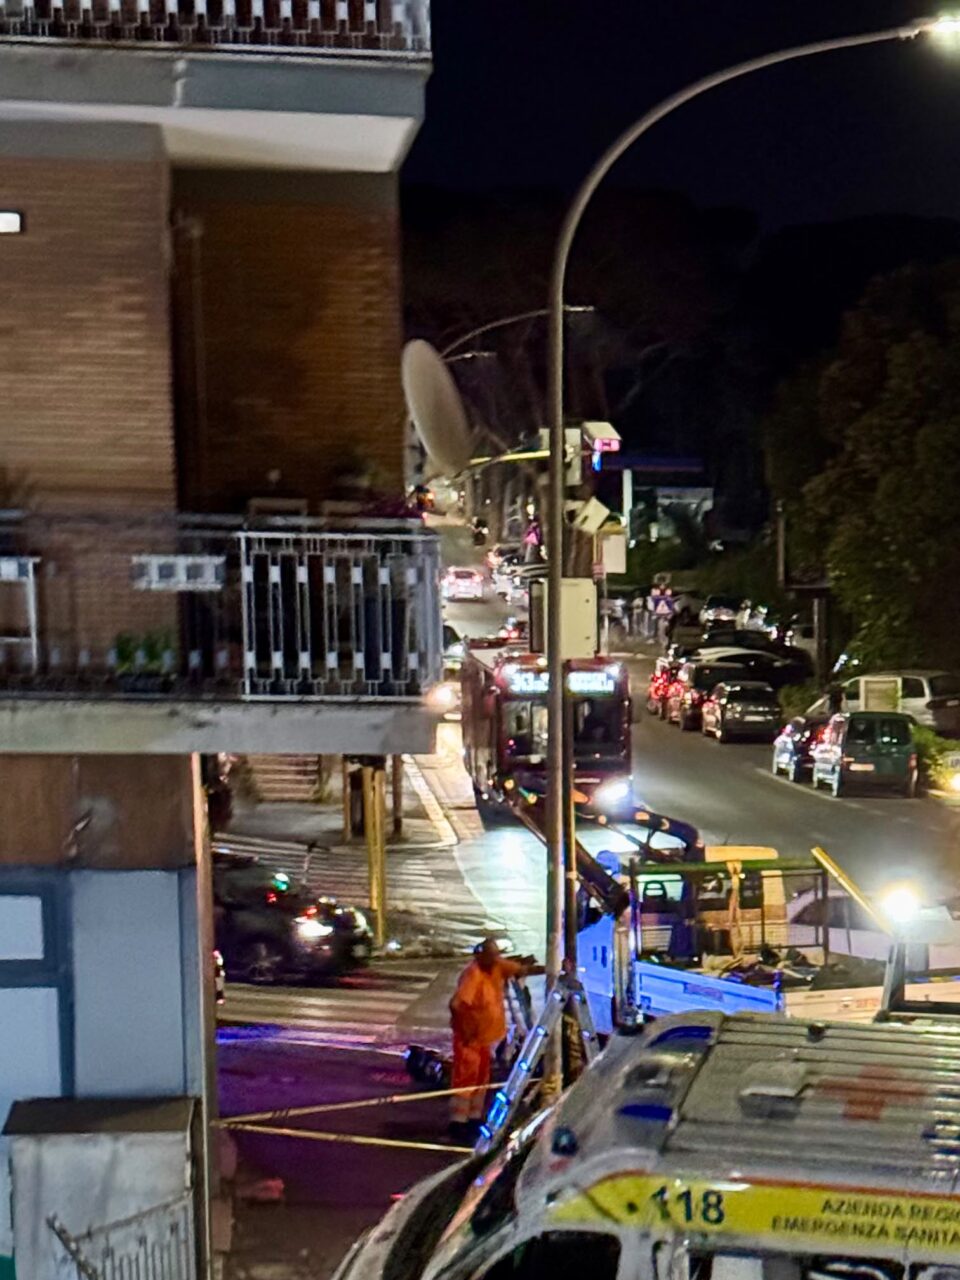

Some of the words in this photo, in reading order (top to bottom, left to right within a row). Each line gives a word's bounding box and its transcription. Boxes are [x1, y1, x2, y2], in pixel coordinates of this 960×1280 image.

[651, 1184, 726, 1224] 118
[821, 1198, 902, 1219] AZIENDA
[771, 1215, 889, 1240] EMERGENZA
